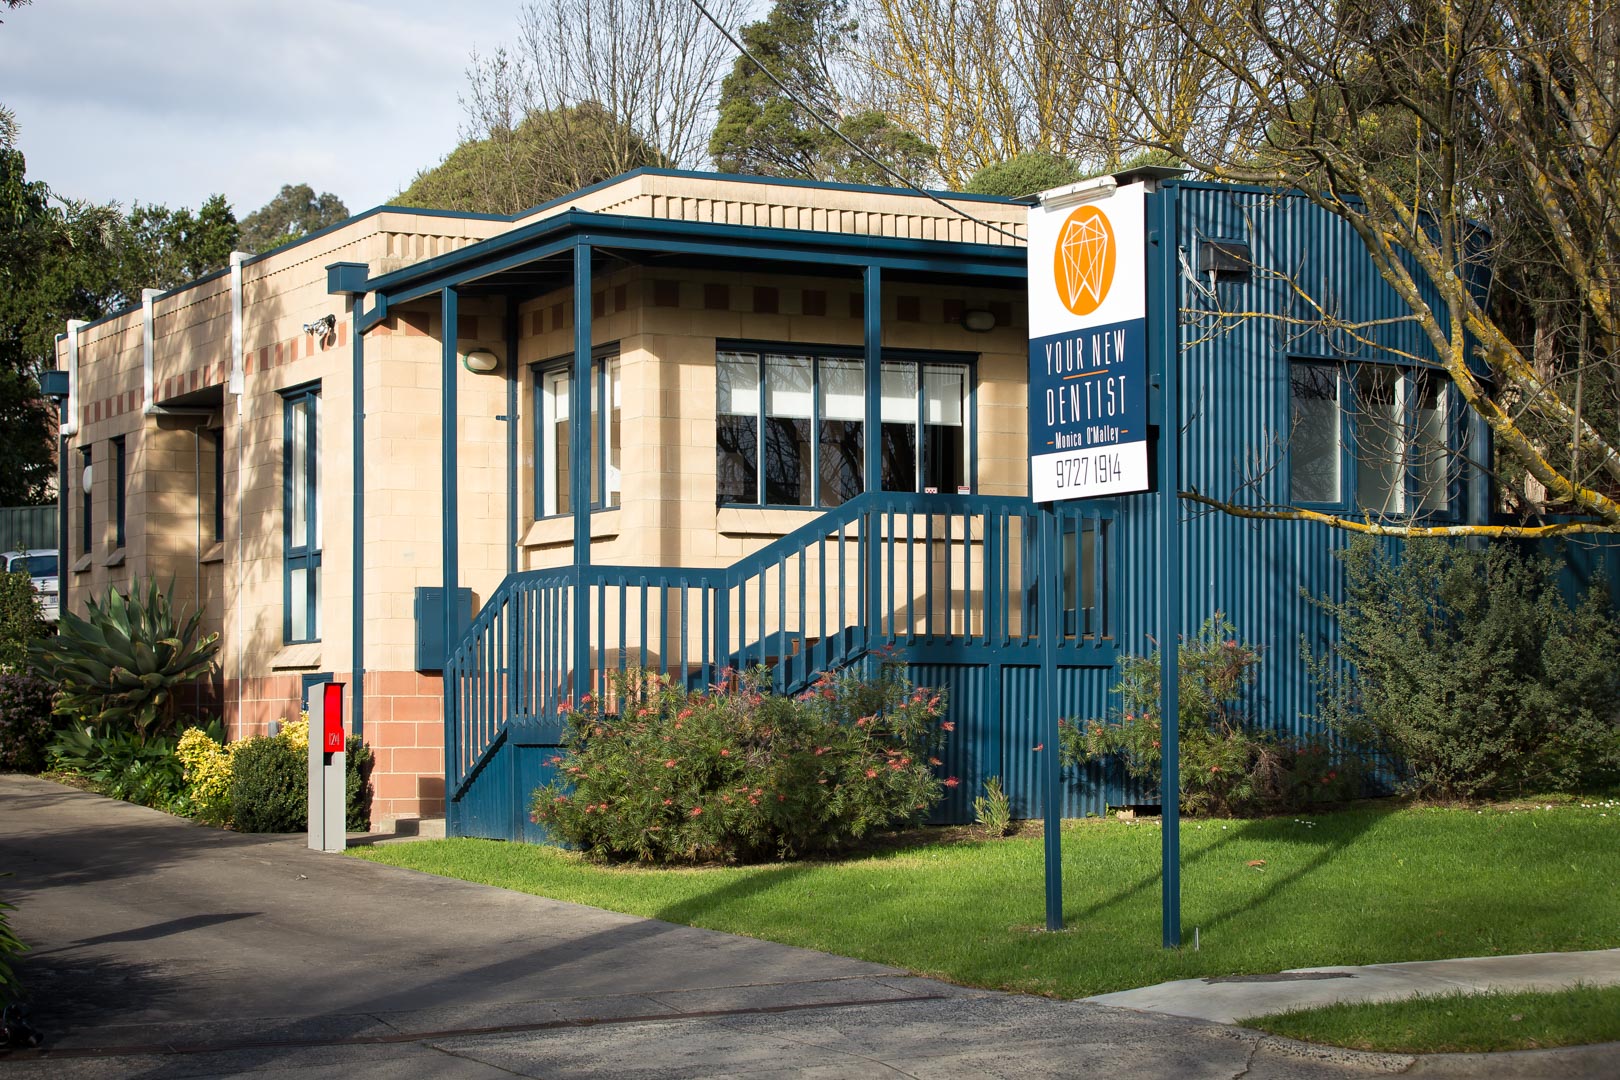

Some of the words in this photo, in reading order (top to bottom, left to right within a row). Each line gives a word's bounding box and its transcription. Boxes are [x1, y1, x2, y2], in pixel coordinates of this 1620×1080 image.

[1045, 337, 1084, 375] YOUR
[1092, 329, 1126, 367] NEW
[1046, 375, 1126, 426] DENTIST
[1055, 431, 1082, 449] Monica
[1087, 425, 1119, 444] O'Malley
[1056, 457, 1089, 488] 9727
[1093, 453, 1121, 484] 1914
